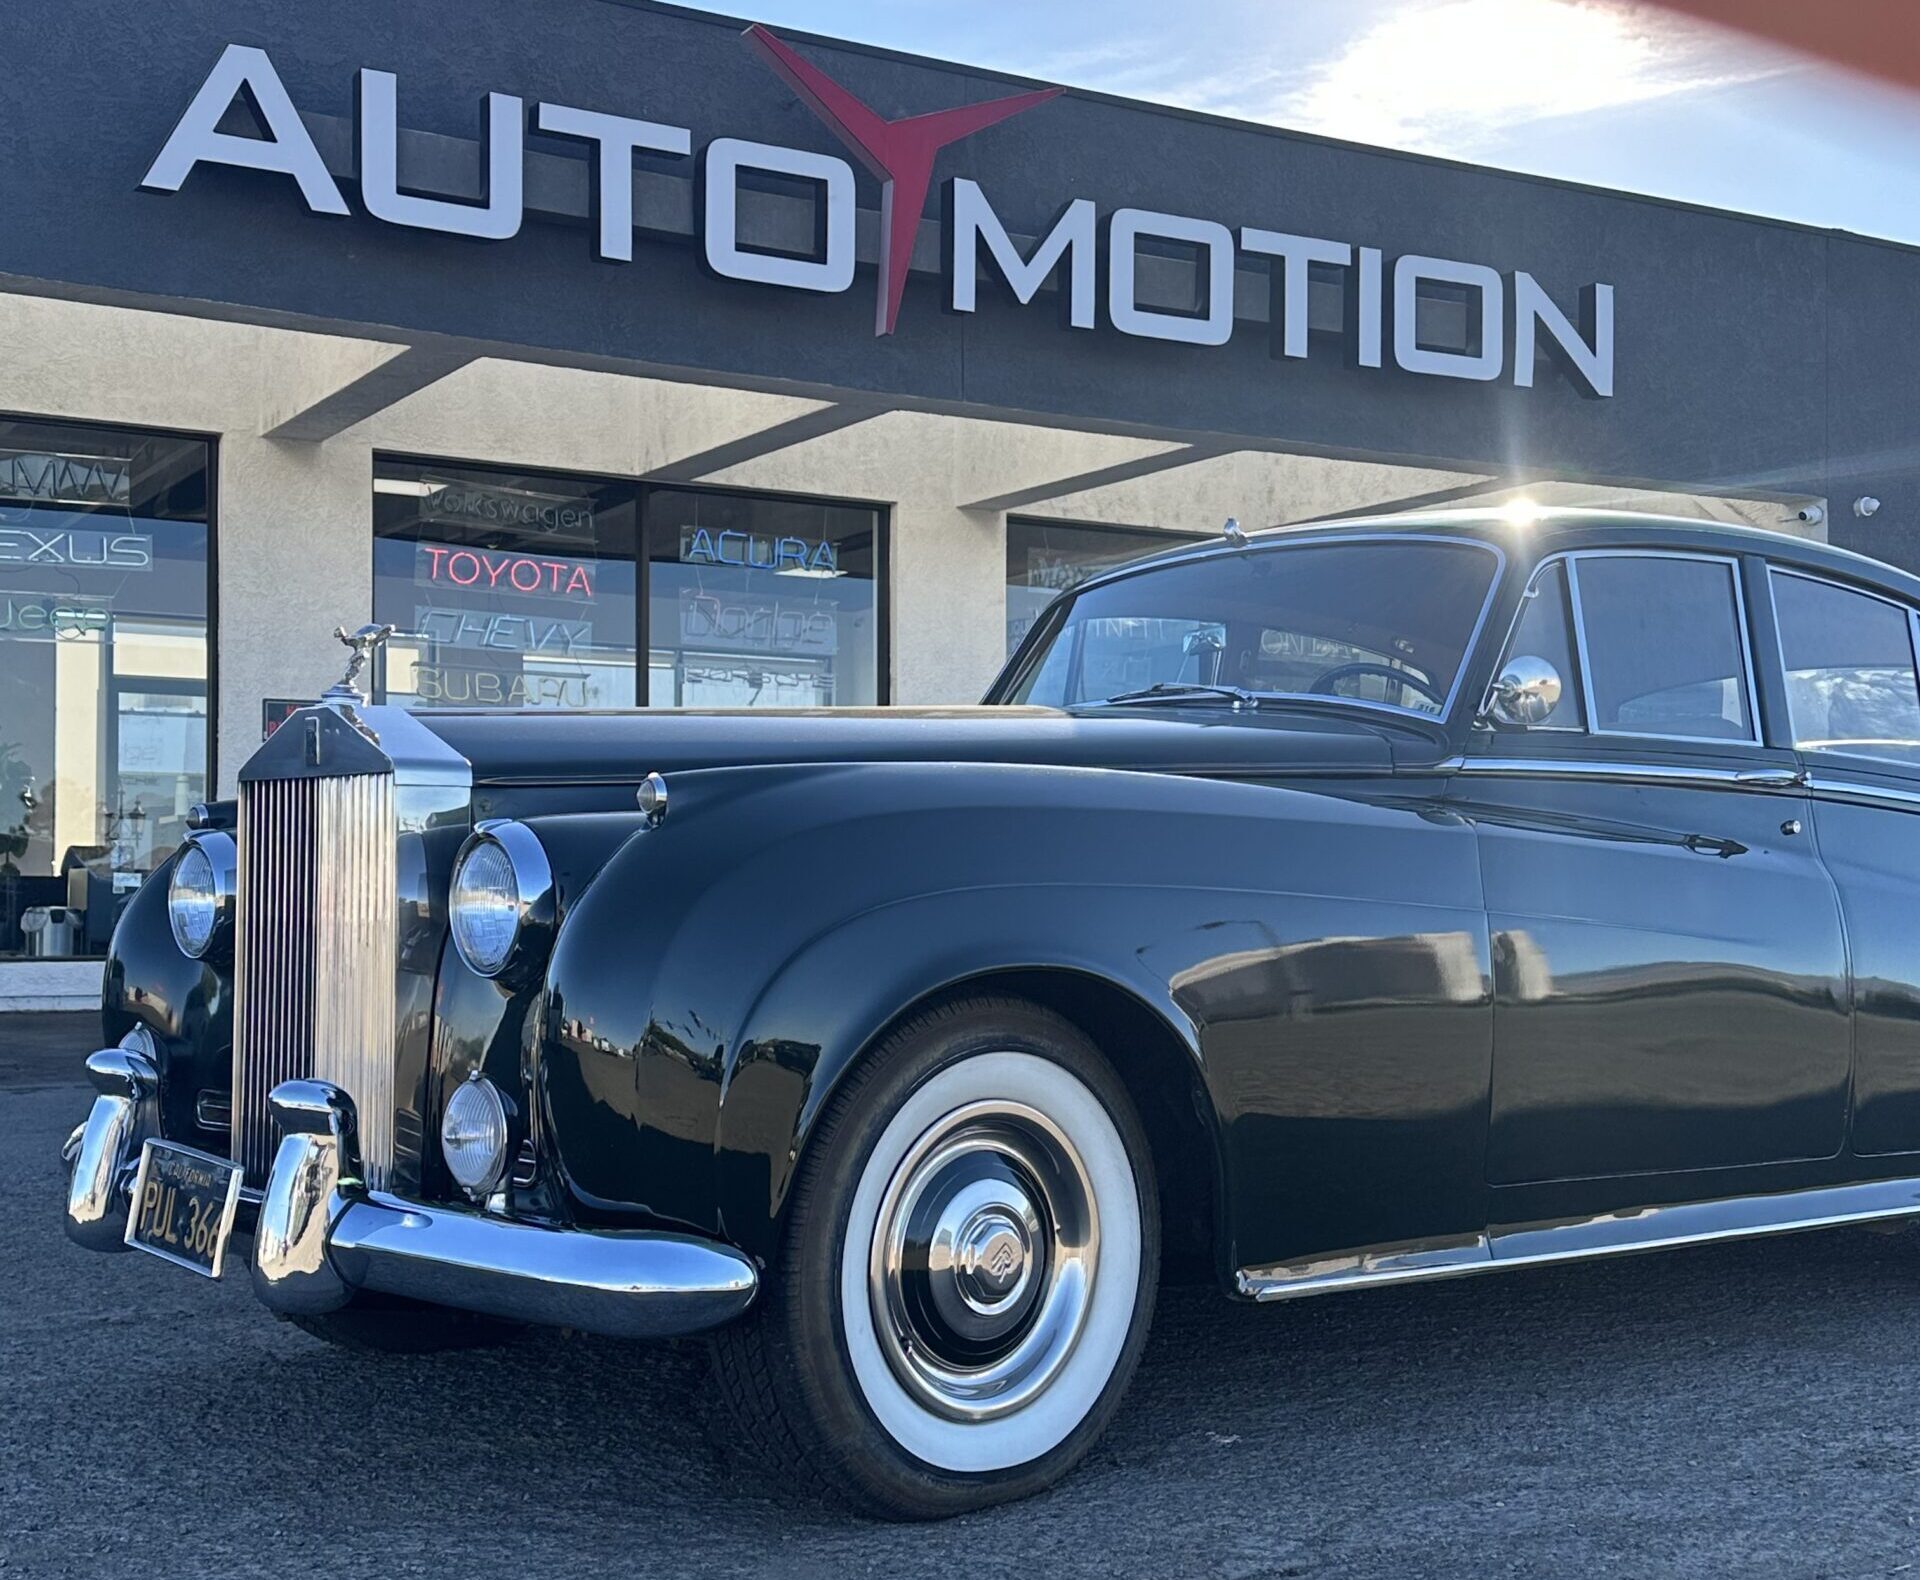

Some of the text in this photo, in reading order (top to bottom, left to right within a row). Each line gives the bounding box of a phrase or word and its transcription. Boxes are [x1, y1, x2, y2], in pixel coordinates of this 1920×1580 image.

[141, 43, 1614, 398] AUTO MOTION
[11, 457, 126, 498] MW
[0, 529, 150, 567] EXUS
[689, 528, 837, 575] ACURA
[424, 547, 592, 598] TOYOTA
[420, 609, 590, 653] CHEVY
[417, 667, 588, 706] SUBARU
[139, 1181, 178, 1245] PUL
